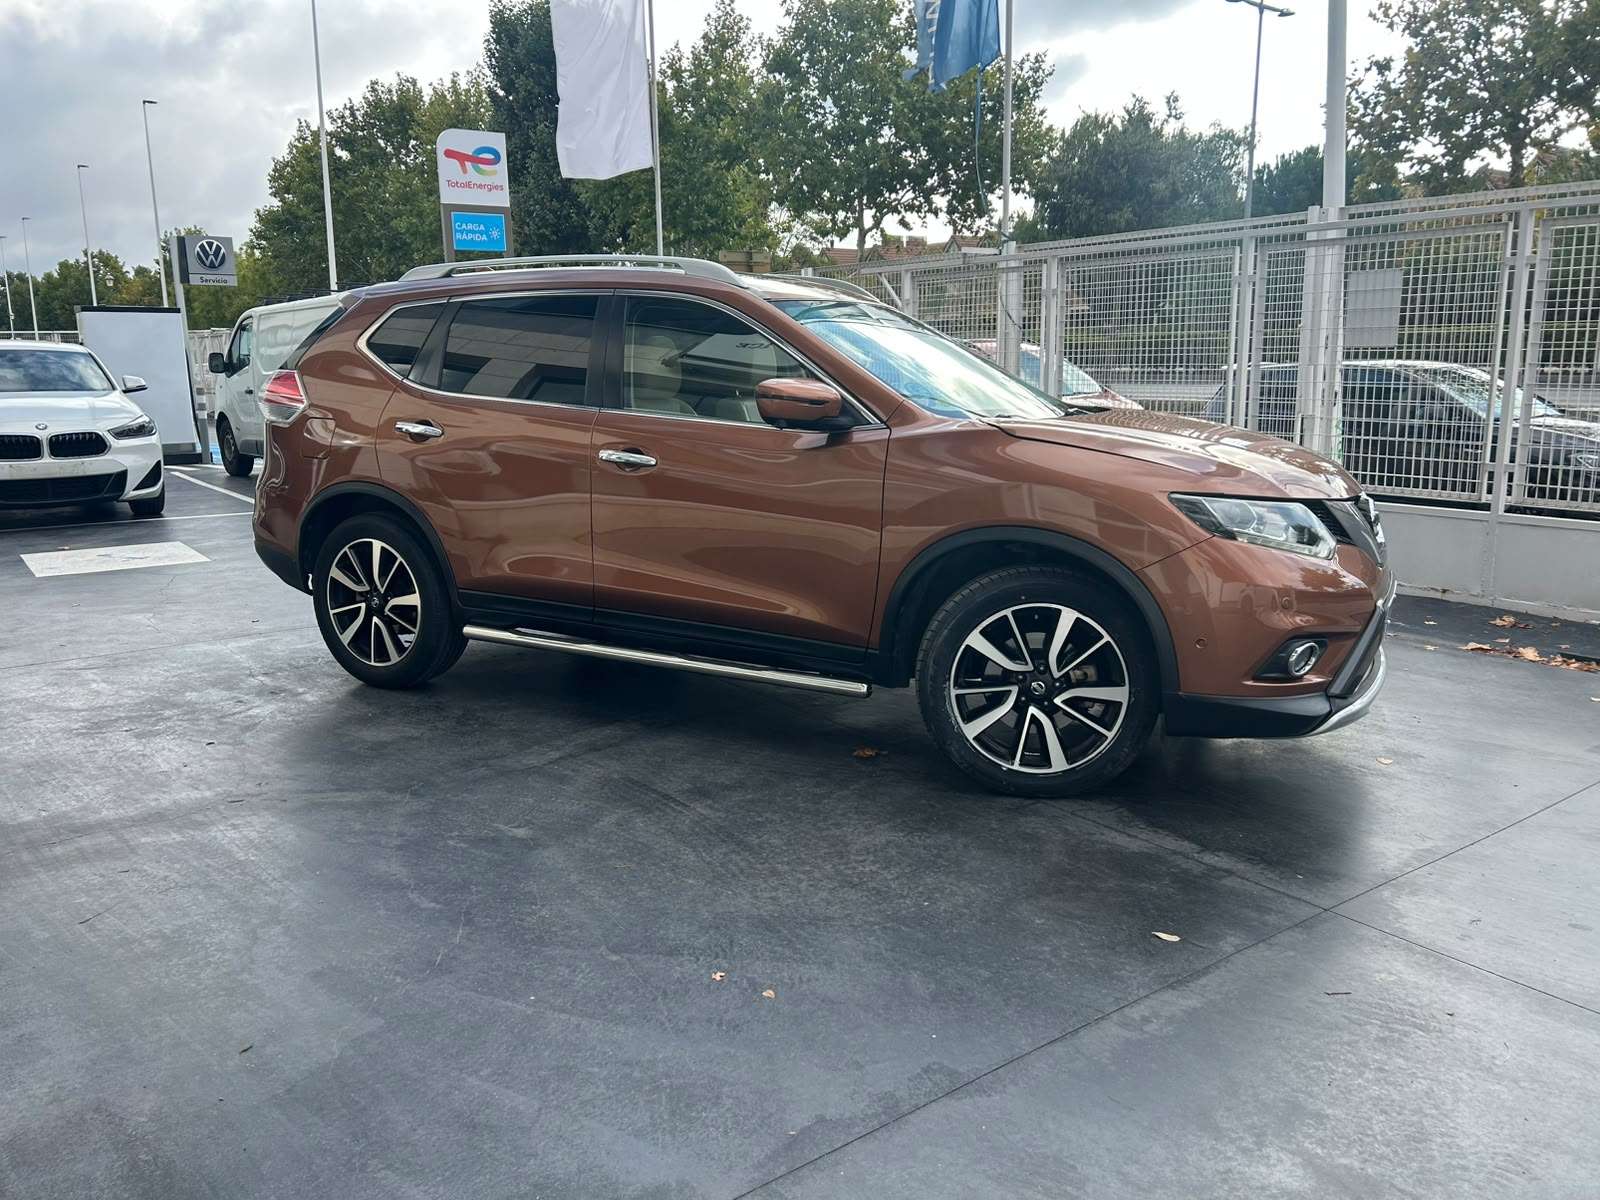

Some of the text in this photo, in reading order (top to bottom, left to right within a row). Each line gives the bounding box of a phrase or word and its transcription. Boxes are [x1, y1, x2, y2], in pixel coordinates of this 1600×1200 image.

[446, 180, 504, 192] TotalEnergies
[455, 222, 485, 231] CARGA
[455, 231, 487, 241] RÁPIDA
